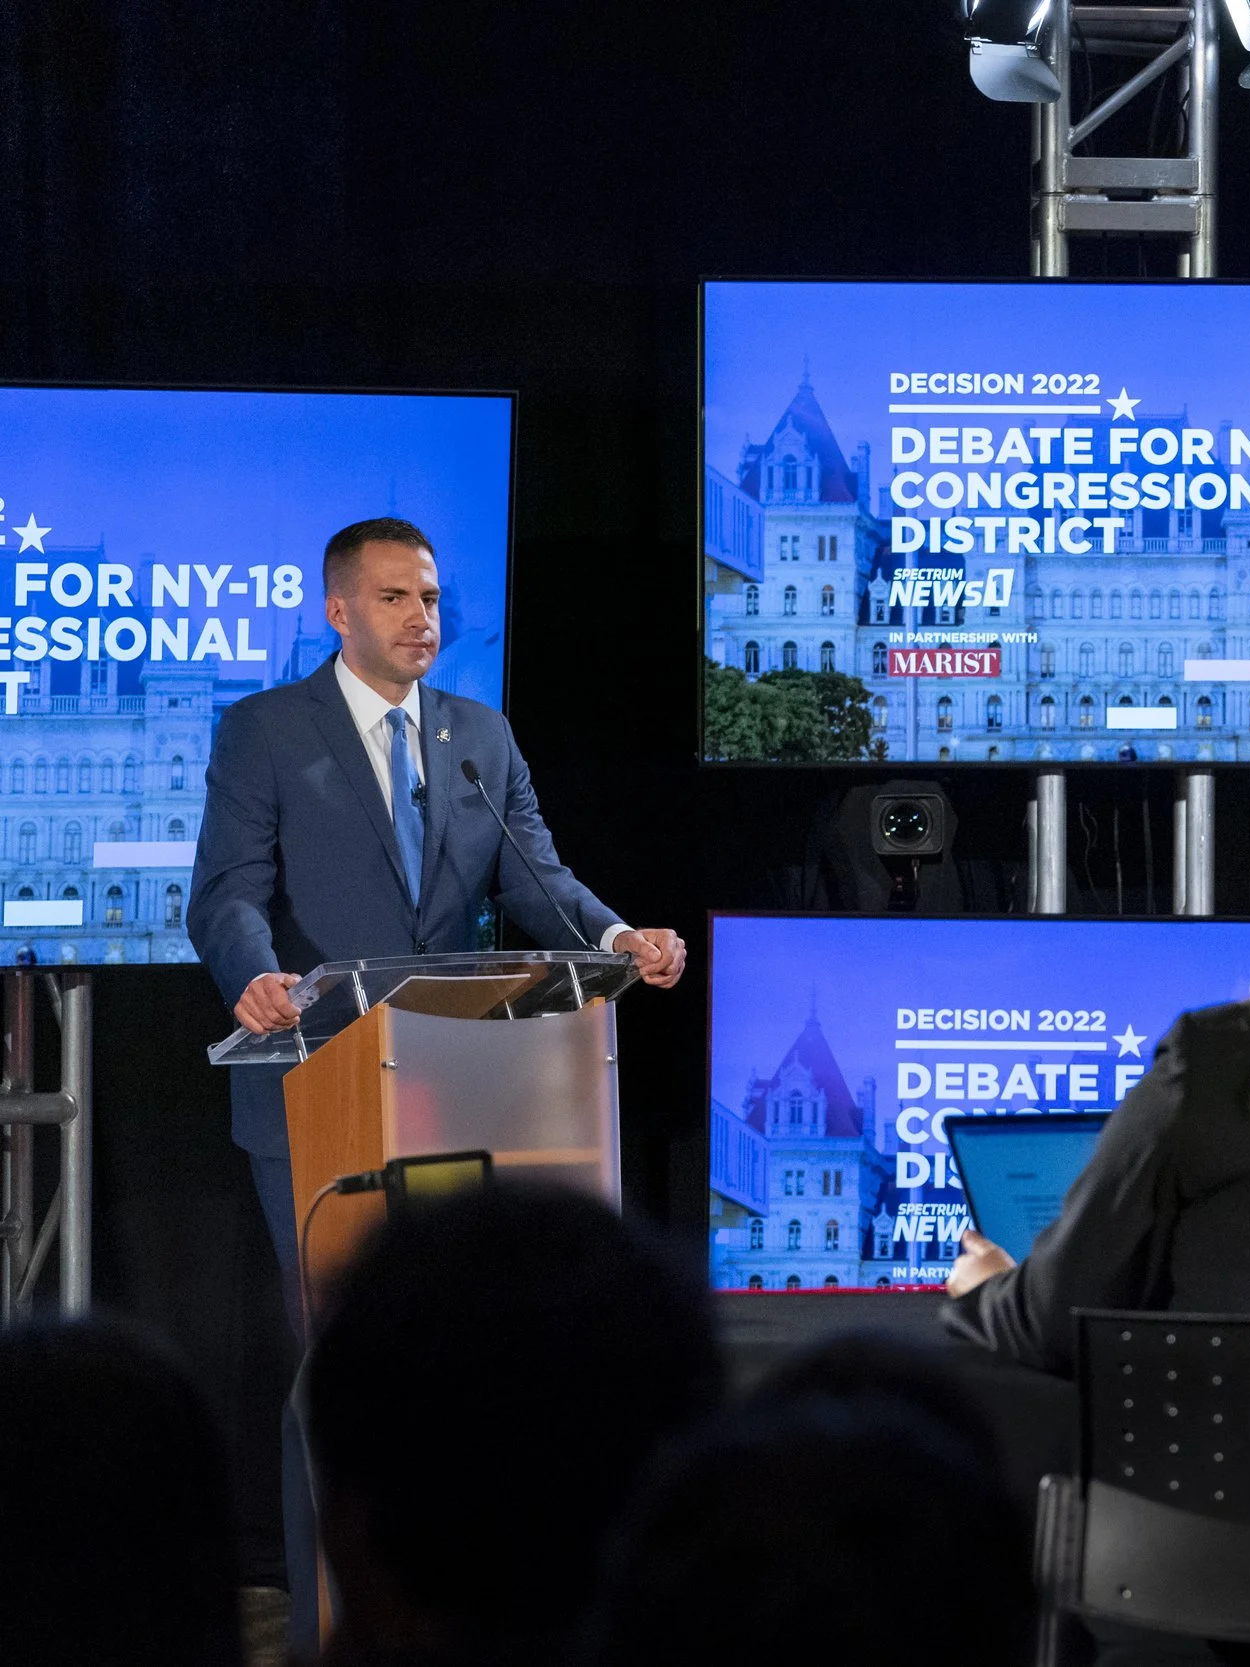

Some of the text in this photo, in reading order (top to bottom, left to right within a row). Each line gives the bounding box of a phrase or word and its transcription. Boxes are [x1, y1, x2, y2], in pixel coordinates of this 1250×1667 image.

[890, 373, 1100, 395] DECISION 2022
[891, 427, 1093, 464] DEBATE
[1109, 428, 1214, 465] FOR
[891, 516, 1125, 554] DISTRICT
[15, 562, 304, 609] FOR NY-18
[893, 568, 963, 581] SPECTRUM
[889, 632, 1038, 644] IN PARTNERSHIP WITH
[893, 652, 997, 674] MARIST
[896, 1008, 1107, 1032] DECISION 2022
[897, 1062, 1099, 1101] DEBATE
[898, 1203, 967, 1216] SPECTRUM
[892, 1267, 907, 1278] IN
